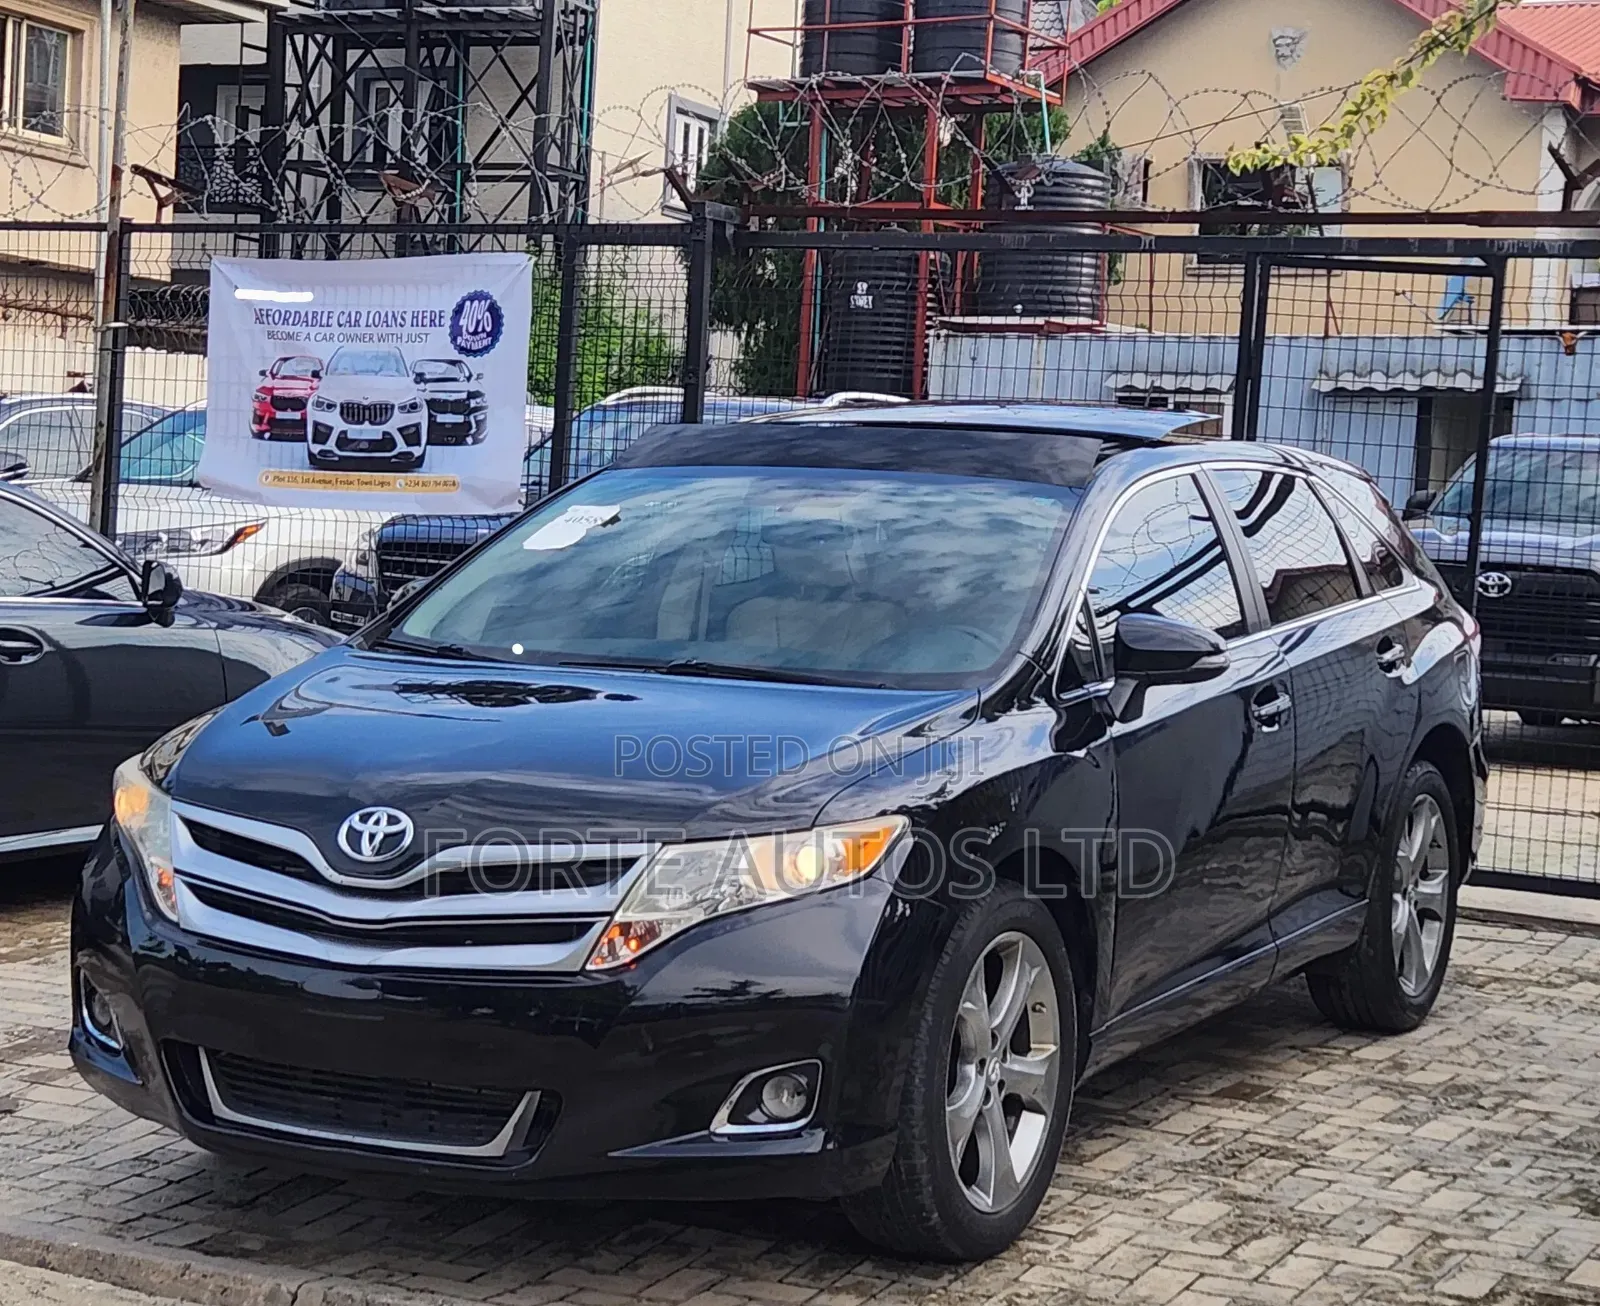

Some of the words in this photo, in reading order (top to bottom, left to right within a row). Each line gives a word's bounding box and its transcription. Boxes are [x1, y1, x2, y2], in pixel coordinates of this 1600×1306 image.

[253, 308, 334, 328] AFFORDABLE
[337, 310, 363, 328] CAR
[365, 310, 407, 328] LOANS
[410, 310, 446, 328] HERE
[459, 299, 493, 333] 40%
[266, 330, 302, 342] BECOME
[303, 332, 312, 342] A
[314, 332, 335, 343] CAR
[337, 332, 375, 344] OWNER
[377, 332, 403, 344] WITH
[405, 332, 431, 344] JUST
[456, 336, 493, 350] PAYMENT
[462, 331, 487, 341] DOWN
[374, 478, 391, 489] Lagos
